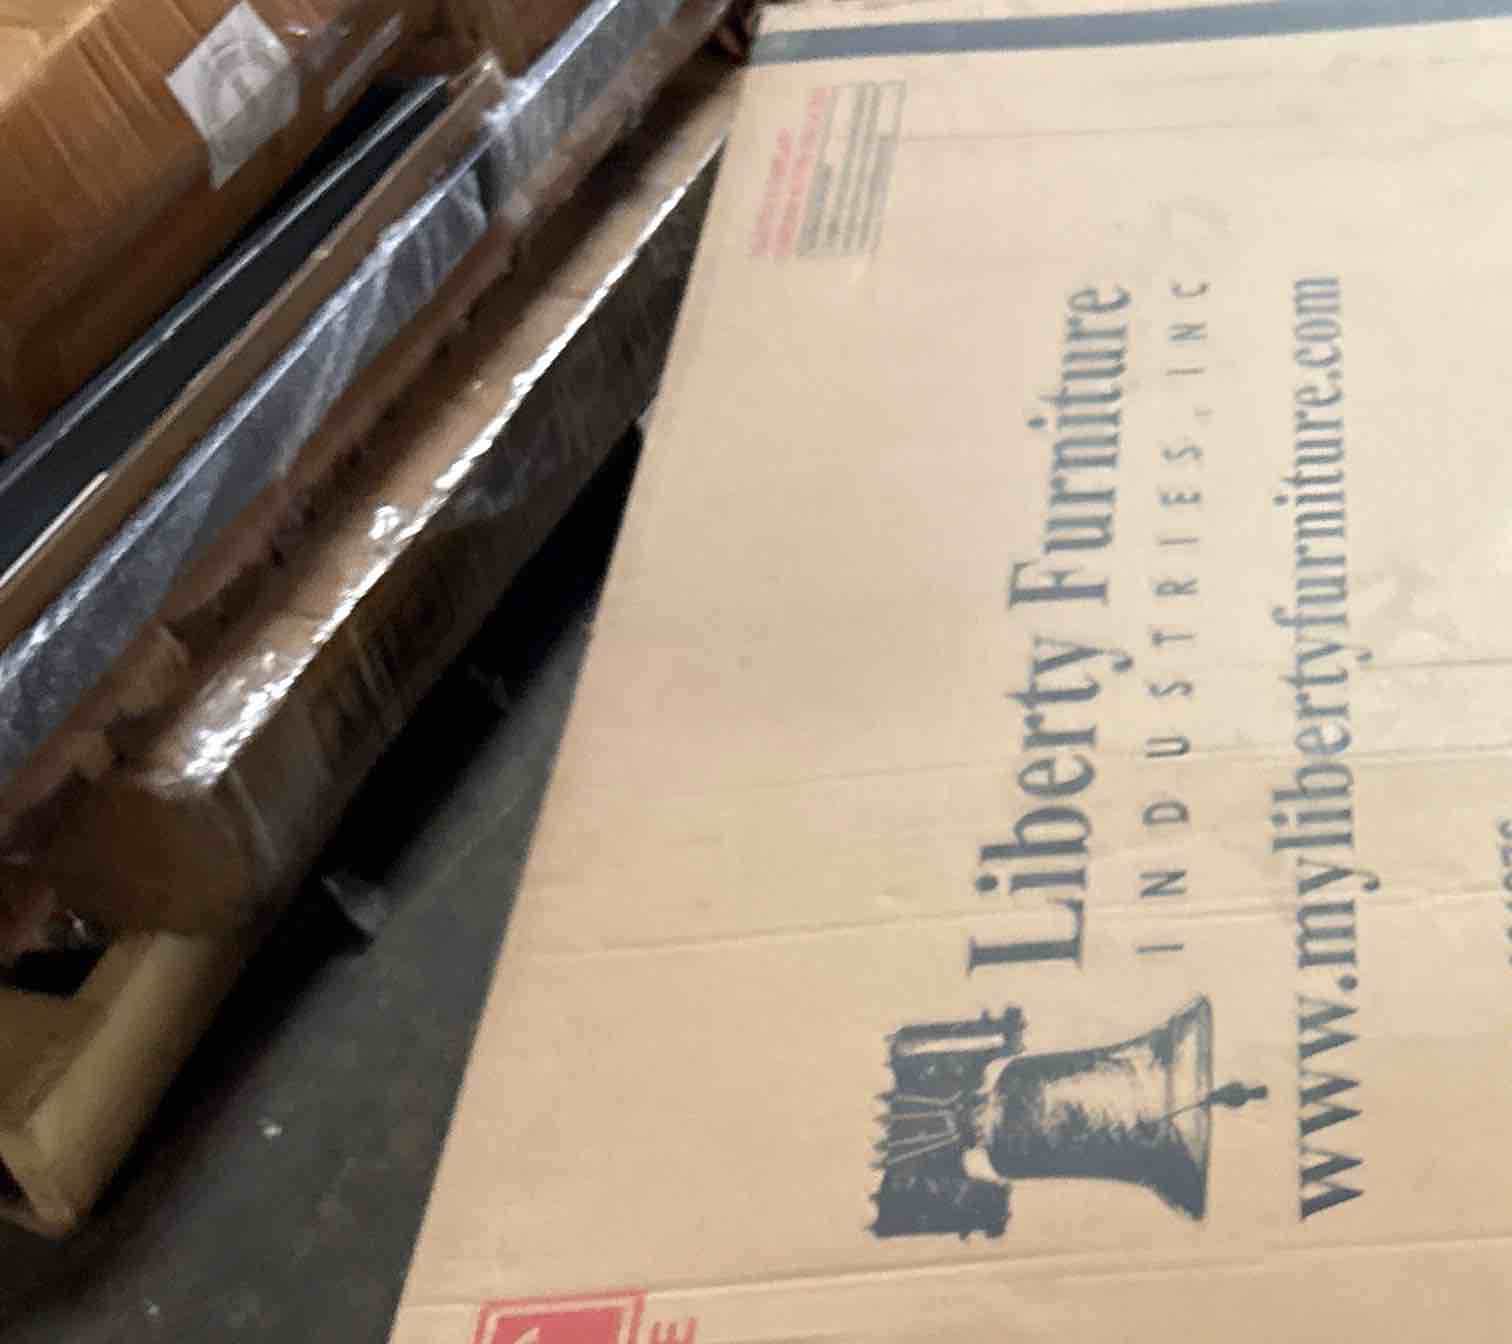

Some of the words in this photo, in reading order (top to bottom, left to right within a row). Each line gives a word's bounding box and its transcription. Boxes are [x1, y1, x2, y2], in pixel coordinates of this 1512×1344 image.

[1006, 283, 1132, 610] Furniture
[964, 635, 1134, 978] Liberty
[1269, 275, 1382, 1223] www.mylibertyfurniture.com
